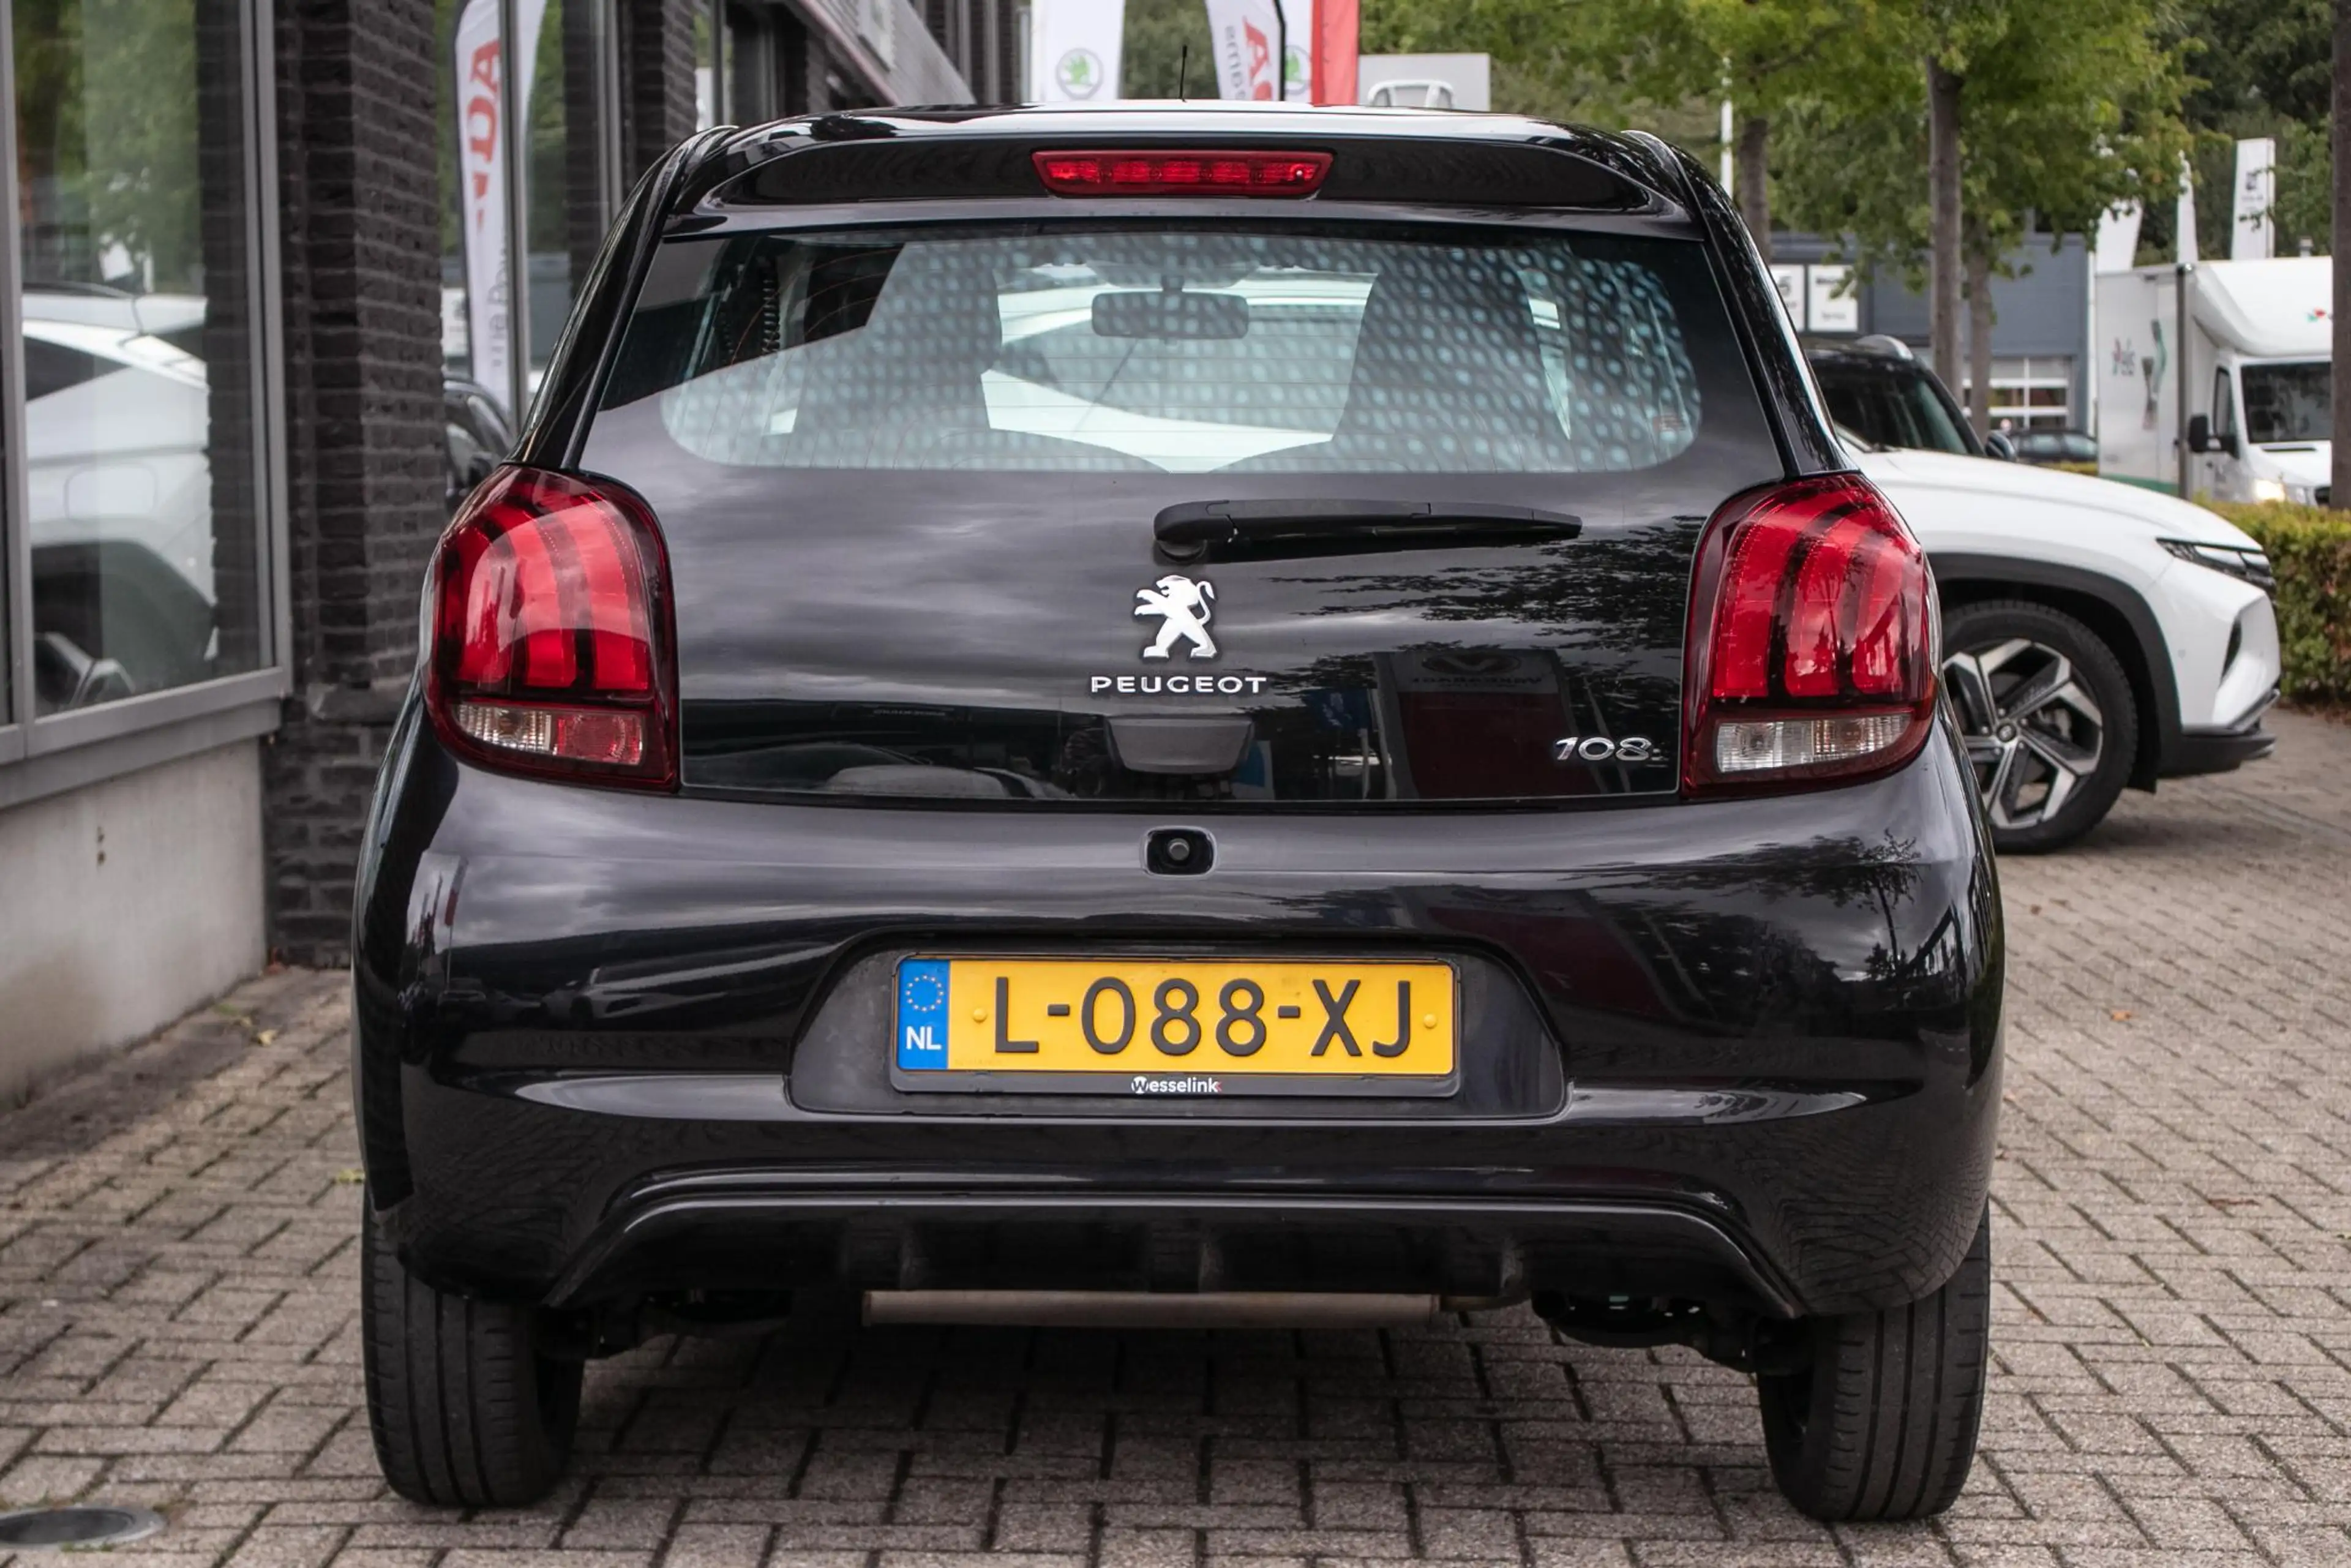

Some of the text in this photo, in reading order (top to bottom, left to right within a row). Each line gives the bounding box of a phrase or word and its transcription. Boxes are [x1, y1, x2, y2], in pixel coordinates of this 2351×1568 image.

[1090, 676, 1267, 694] PEUGEOT
[1555, 737, 1652, 761] 108
[994, 977, 1411, 1058] L-088-XJ
[906, 1026, 942, 1050] NL
[1131, 1076, 1219, 1094] Wesselink
